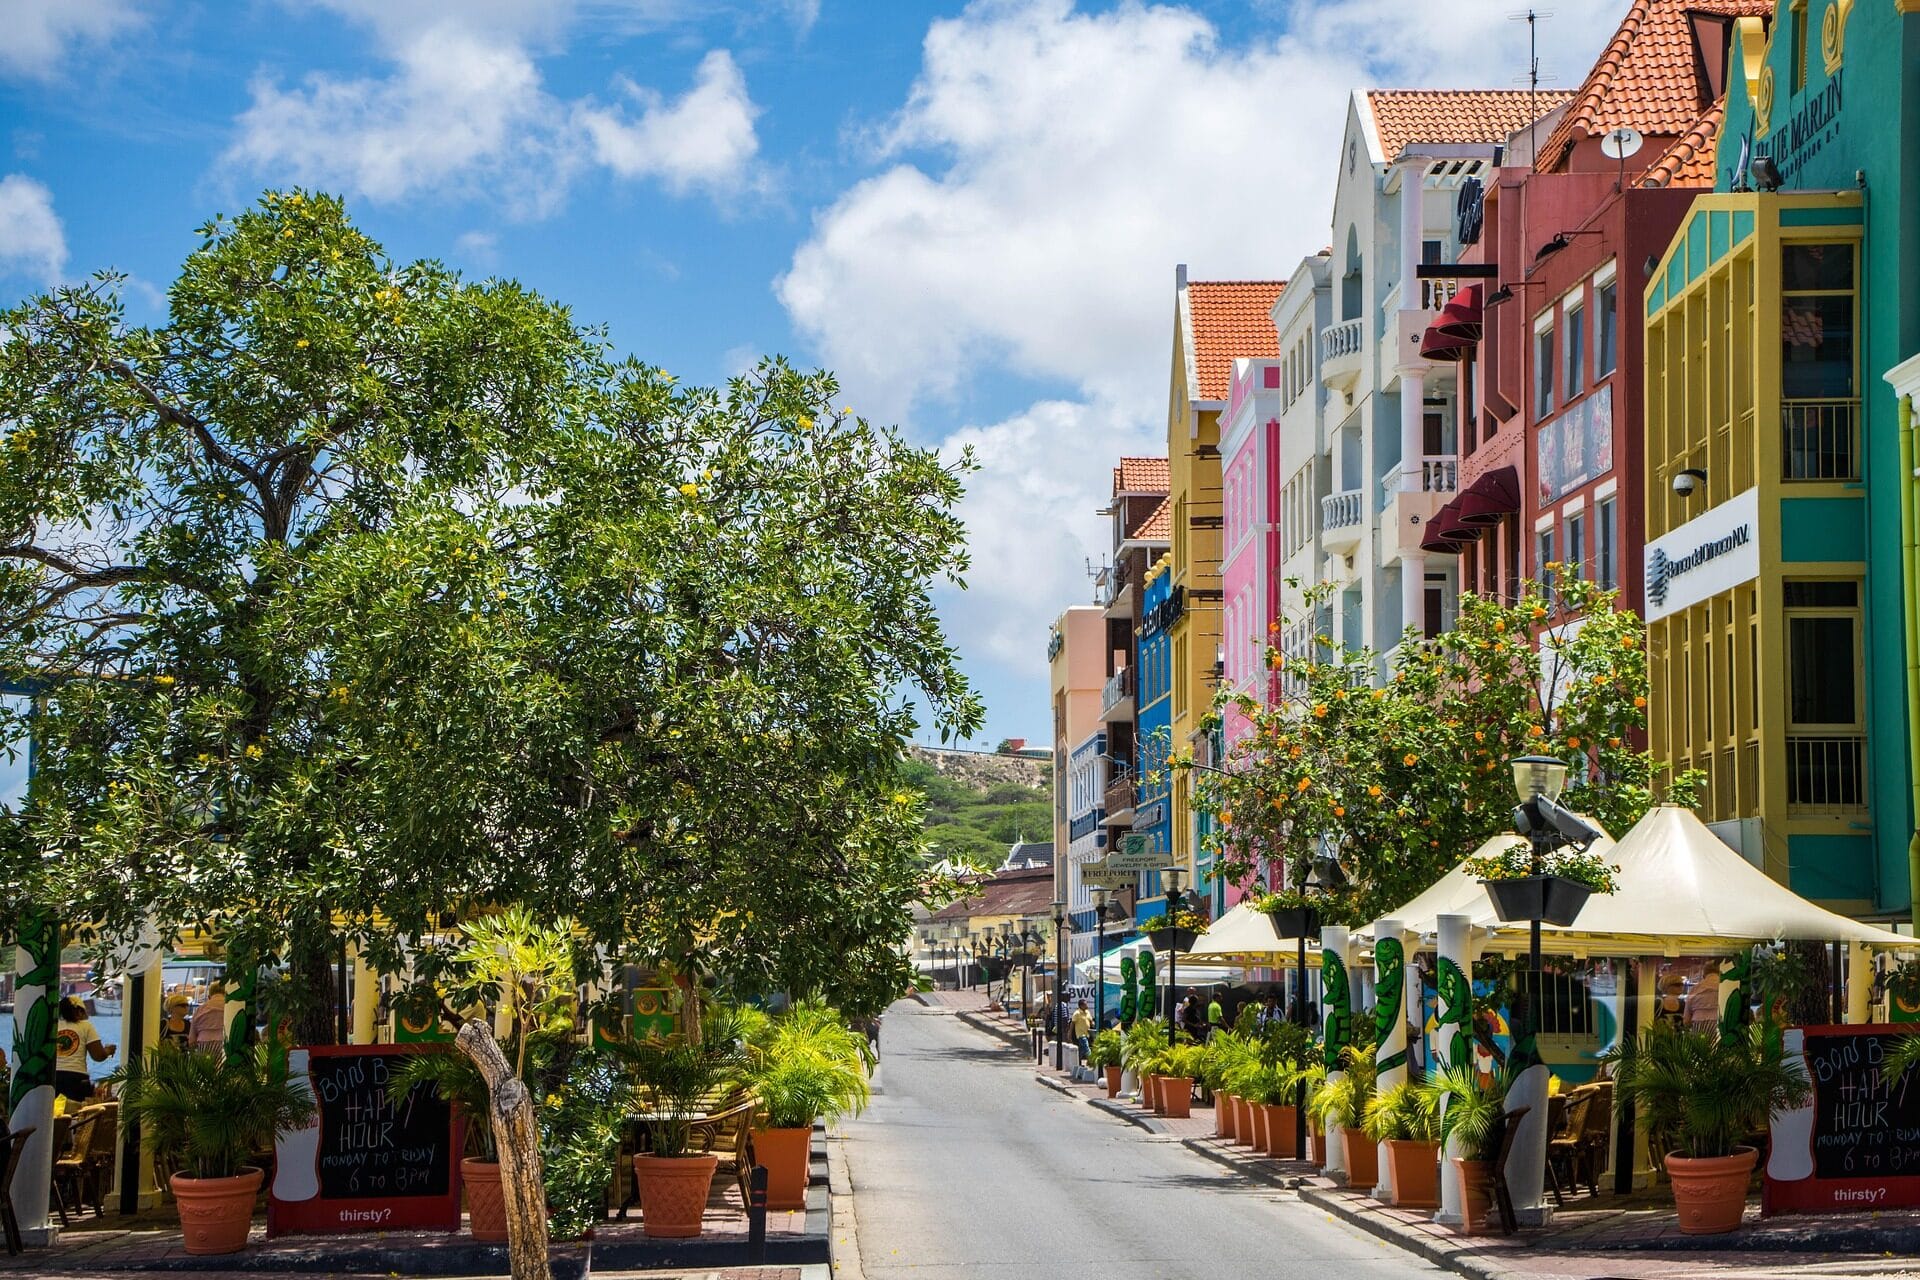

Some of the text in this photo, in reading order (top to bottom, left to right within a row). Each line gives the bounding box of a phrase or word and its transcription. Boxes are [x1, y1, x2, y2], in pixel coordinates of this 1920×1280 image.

[1790, 68, 1843, 154] MARLIN
[1814, 1036, 1859, 1082] BON
[319, 1057, 364, 1102] BON
[1833, 1101, 1889, 1132] HOUR
[339, 1121, 394, 1152] HOUR
[1816, 1131, 1863, 1148] MONDAY
[1869, 1132, 1883, 1145] TO
[322, 1144, 436, 1168] MONDAY TO RIDAY
[1844, 1148, 1854, 1171] 6
[1864, 1155, 1880, 1169] TO
[350, 1168, 360, 1191] 6
[369, 1175, 386, 1188] TO
[1834, 1188, 1886, 1203] thirsty?
[339, 1208, 392, 1223] thirsty?
